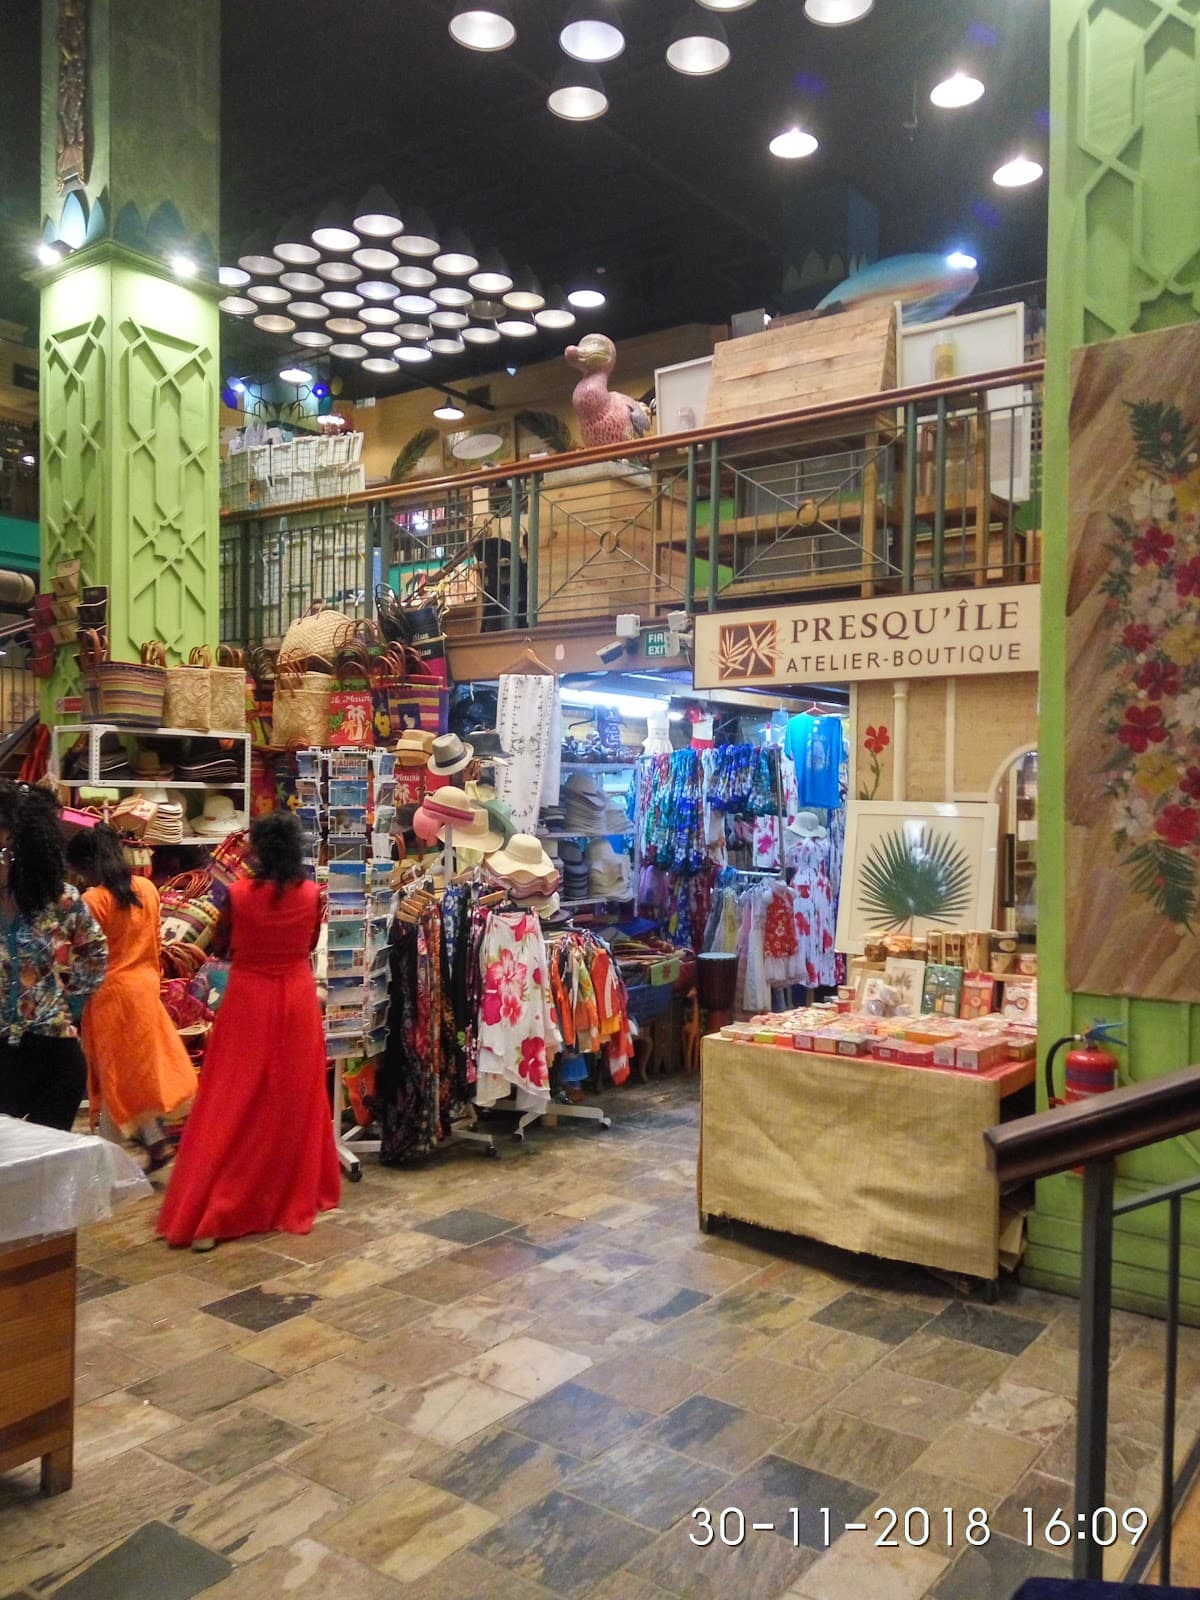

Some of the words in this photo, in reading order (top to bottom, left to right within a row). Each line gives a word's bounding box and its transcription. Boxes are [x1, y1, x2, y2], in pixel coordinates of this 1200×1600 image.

[791, 598, 1019, 643] PRESQU'ÎLE
[648, 633, 664, 643] FIR
[786, 643, 1021, 673] ATELIER-BOUTIQUE
